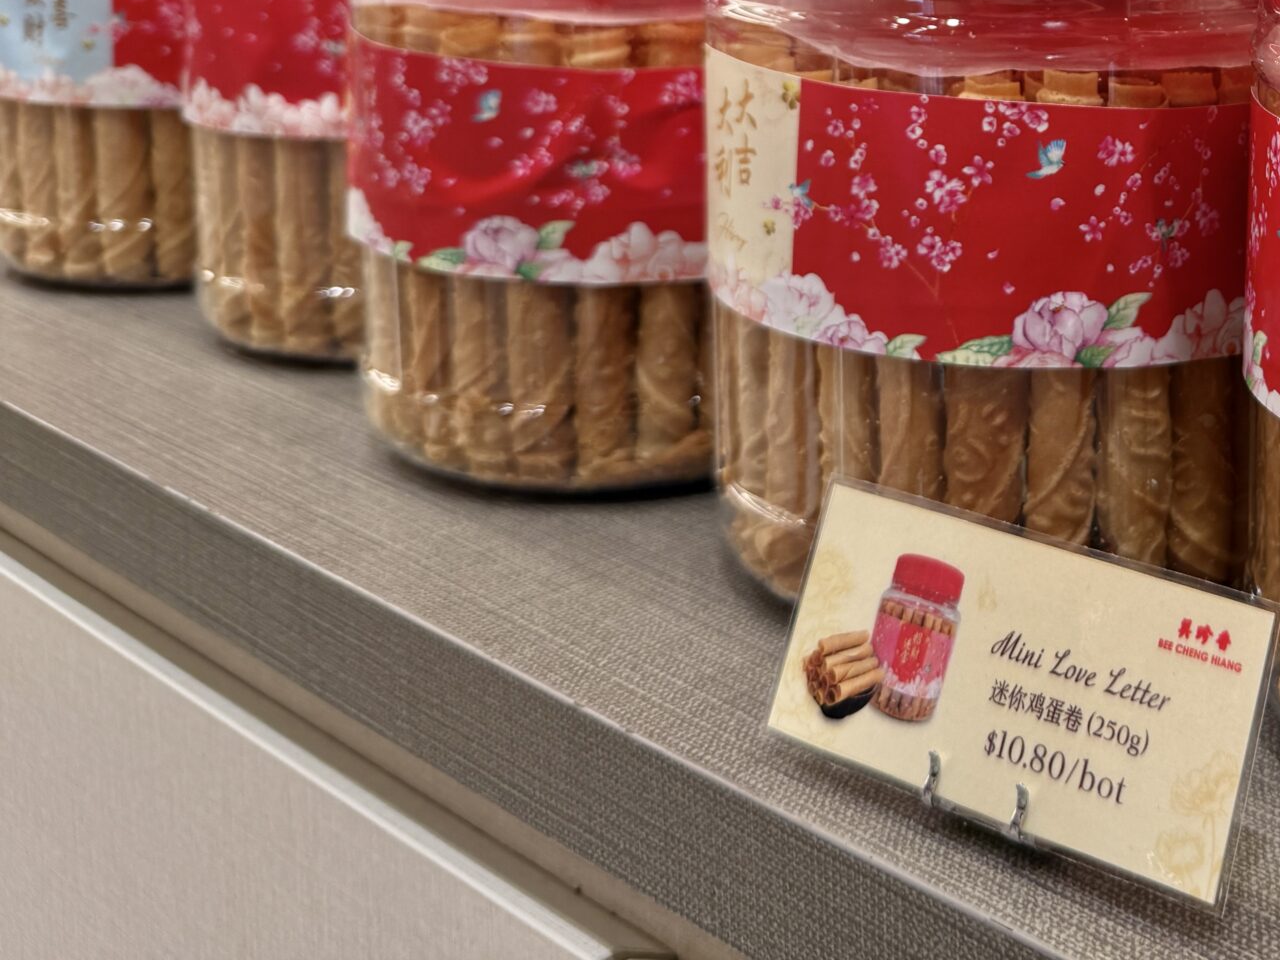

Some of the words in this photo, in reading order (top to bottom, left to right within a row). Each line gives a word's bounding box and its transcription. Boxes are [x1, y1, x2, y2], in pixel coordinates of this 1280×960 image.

[714, 86, 734, 199] 大利
[734, 78, 758, 185] 大吉
[990, 630, 1045, 670] Mini
[1049, 648, 1097, 688] Love
[1103, 666, 1172, 713] Letter
[1157, 637, 1175, 652] BEE
[1175, 643, 1209, 663] CHENG
[1210, 653, 1243, 673] HIANG
[988, 678, 1084, 734] 迷你鸡蛋卷
[1086, 710, 1150, 758] (250g)
[984, 728, 1128, 805] $10.80/bot
